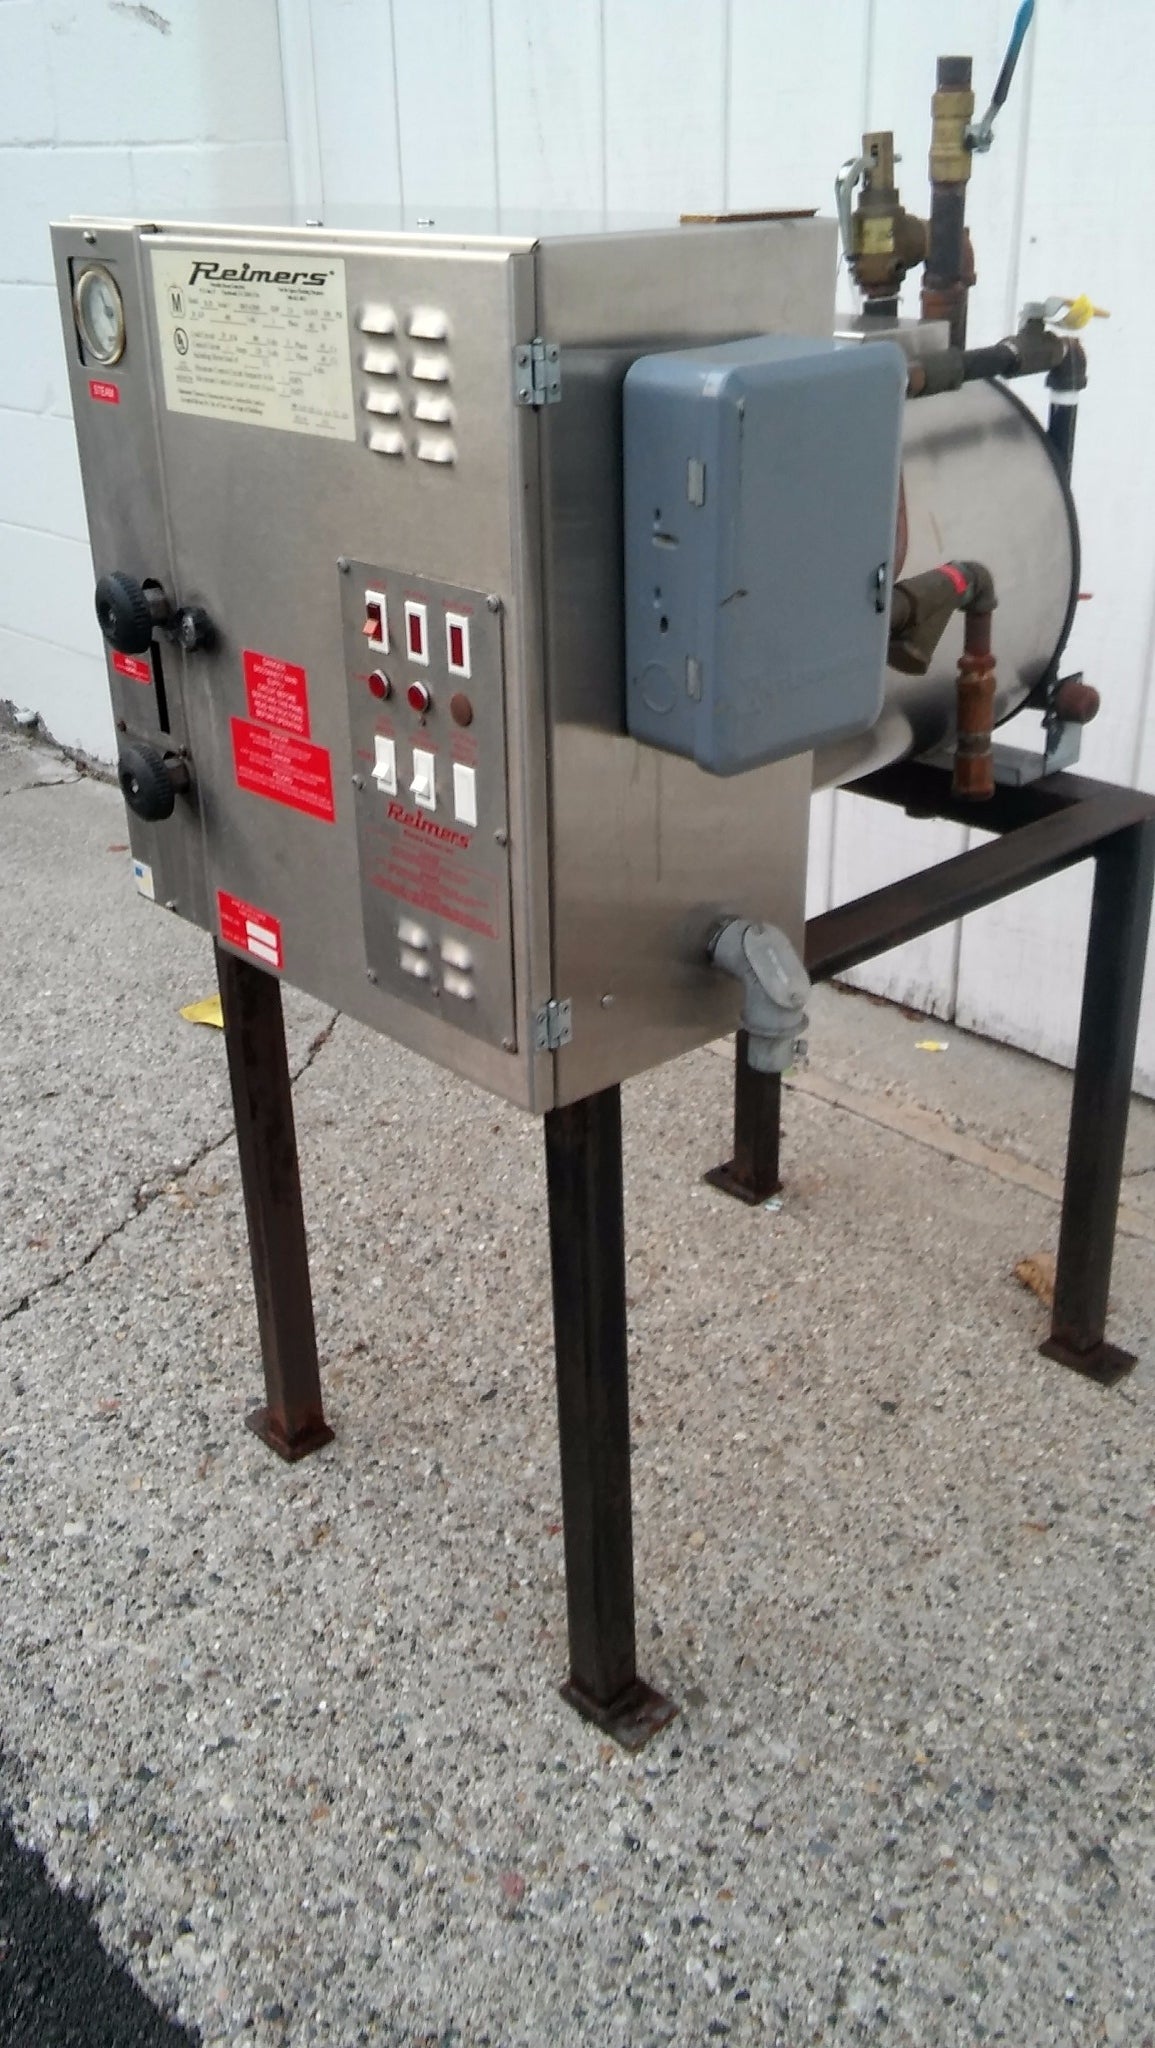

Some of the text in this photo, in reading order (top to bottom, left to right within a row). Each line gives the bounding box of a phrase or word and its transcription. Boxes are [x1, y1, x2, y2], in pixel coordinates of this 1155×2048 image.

[188, 261, 329, 287] Reimers
[93, 384, 115, 398] STEAM
[387, 801, 469, 849] Reimers
